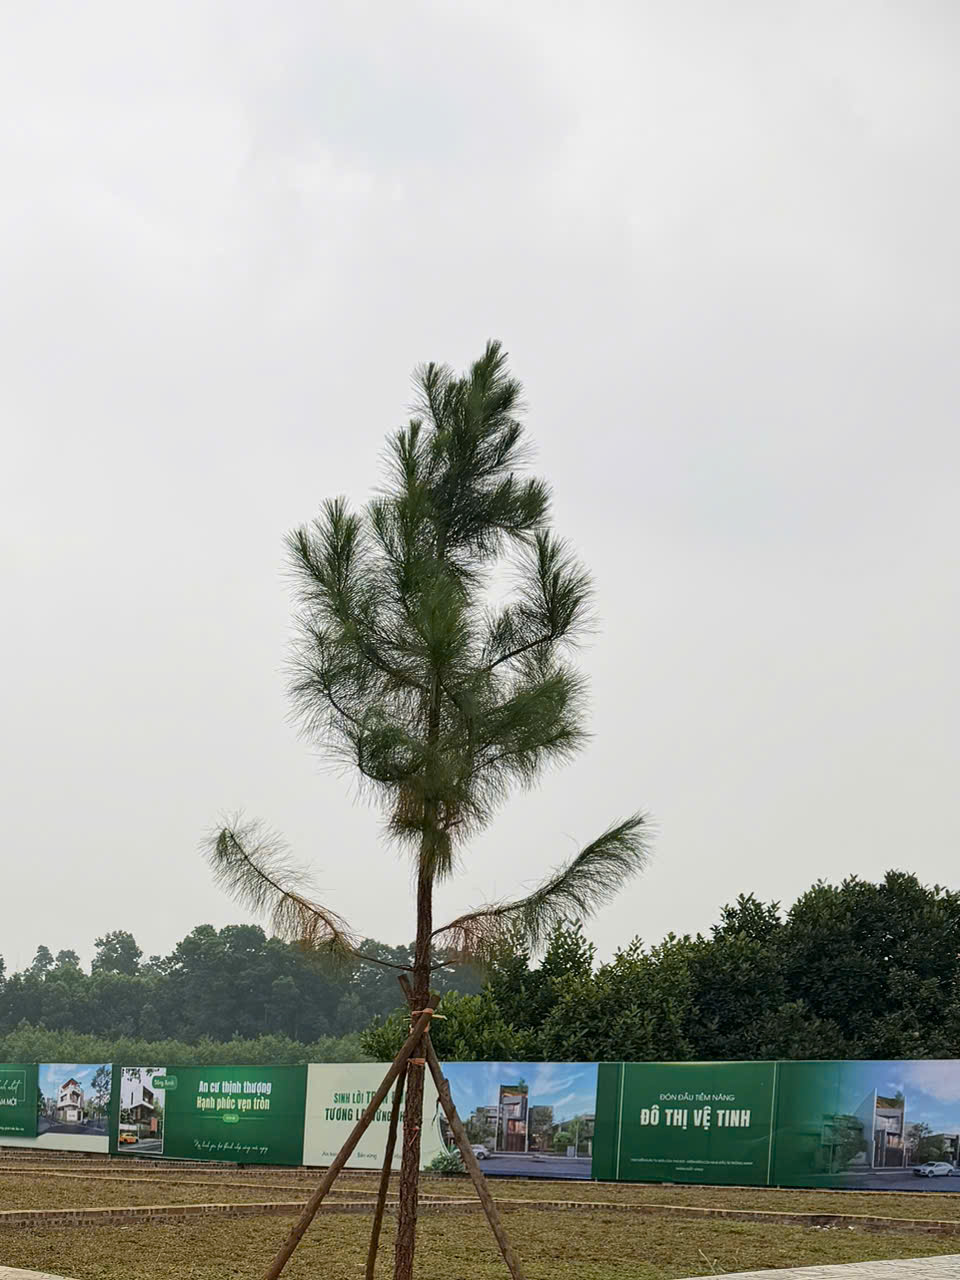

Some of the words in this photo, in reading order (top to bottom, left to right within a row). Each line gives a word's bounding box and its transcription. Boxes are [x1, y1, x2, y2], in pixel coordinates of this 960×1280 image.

[199, 1080, 209, 1093] An
[209, 1081, 221, 1093] cư
[221, 1080, 241, 1096] thịnh
[243, 1081, 272, 1096] thượng
[196, 1096, 215, 1111] Hạnh
[216, 1096, 236, 1111] phúc
[237, 1098, 252, 1112] vẹn
[253, 1096, 270, 1110] tròn
[333, 1092, 351, 1104] SINH
[352, 1090, 364, 1104] LỜI
[660, 1093, 677, 1101] ĐÓN
[678, 1092, 694, 1101] ĐẦU
[695, 1092, 711, 1101] TIỀM
[712, 1093, 735, 1101] NĂNG
[325, 1107, 353, 1121] TƯƠNG
[640, 1104, 660, 1126] ĐÔ
[664, 1108, 688, 1130] THỊ
[693, 1105, 712, 1131] VỆ
[716, 1109, 751, 1127] TINH
